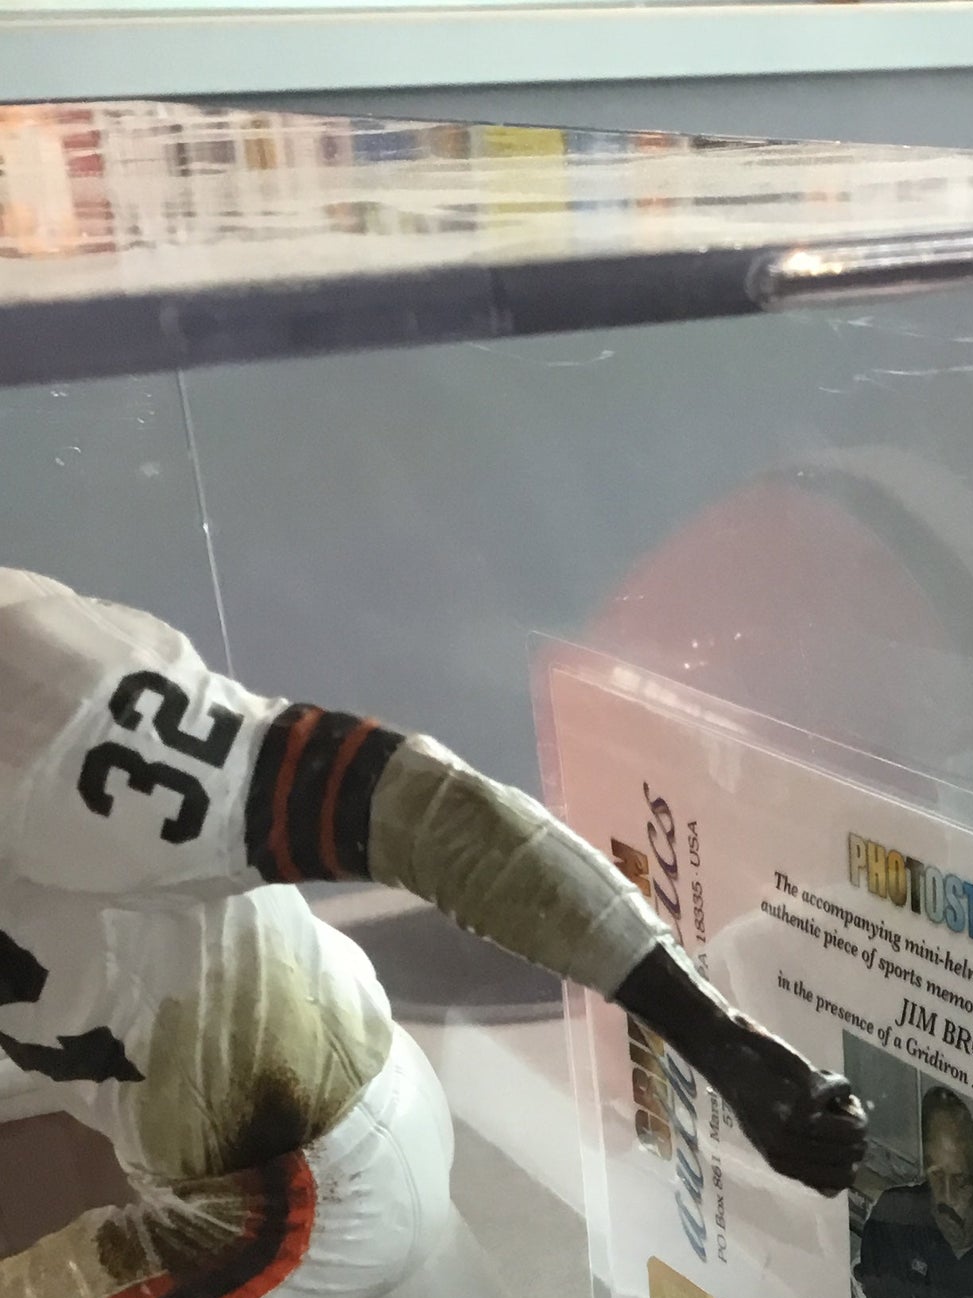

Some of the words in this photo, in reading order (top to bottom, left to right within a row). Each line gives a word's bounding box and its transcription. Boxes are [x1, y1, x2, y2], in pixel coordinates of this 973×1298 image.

[78, 670, 245, 844] 32
[687, 820, 701, 868] USA
[691, 881, 707, 944] 18335
[774, 869, 798, 897] The
[801, 890, 902, 952] accompanying
[761, 899, 821, 938] authentic
[823, 928, 859, 958] piece
[861, 948, 877, 969] of
[878, 957, 922, 988] sports
[778, 970, 790, 991] in
[793, 981, 814, 1002] the
[815, 994, 875, 1035] presence
[877, 1026, 893, 1047] of
[893, 1036, 903, 1050] a
[906, 1036, 969, 1085] Gridiron
[895, 998, 938, 1037] JIM
[713, 1195, 728, 1231] Box
[715, 1233, 728, 1265] PO
